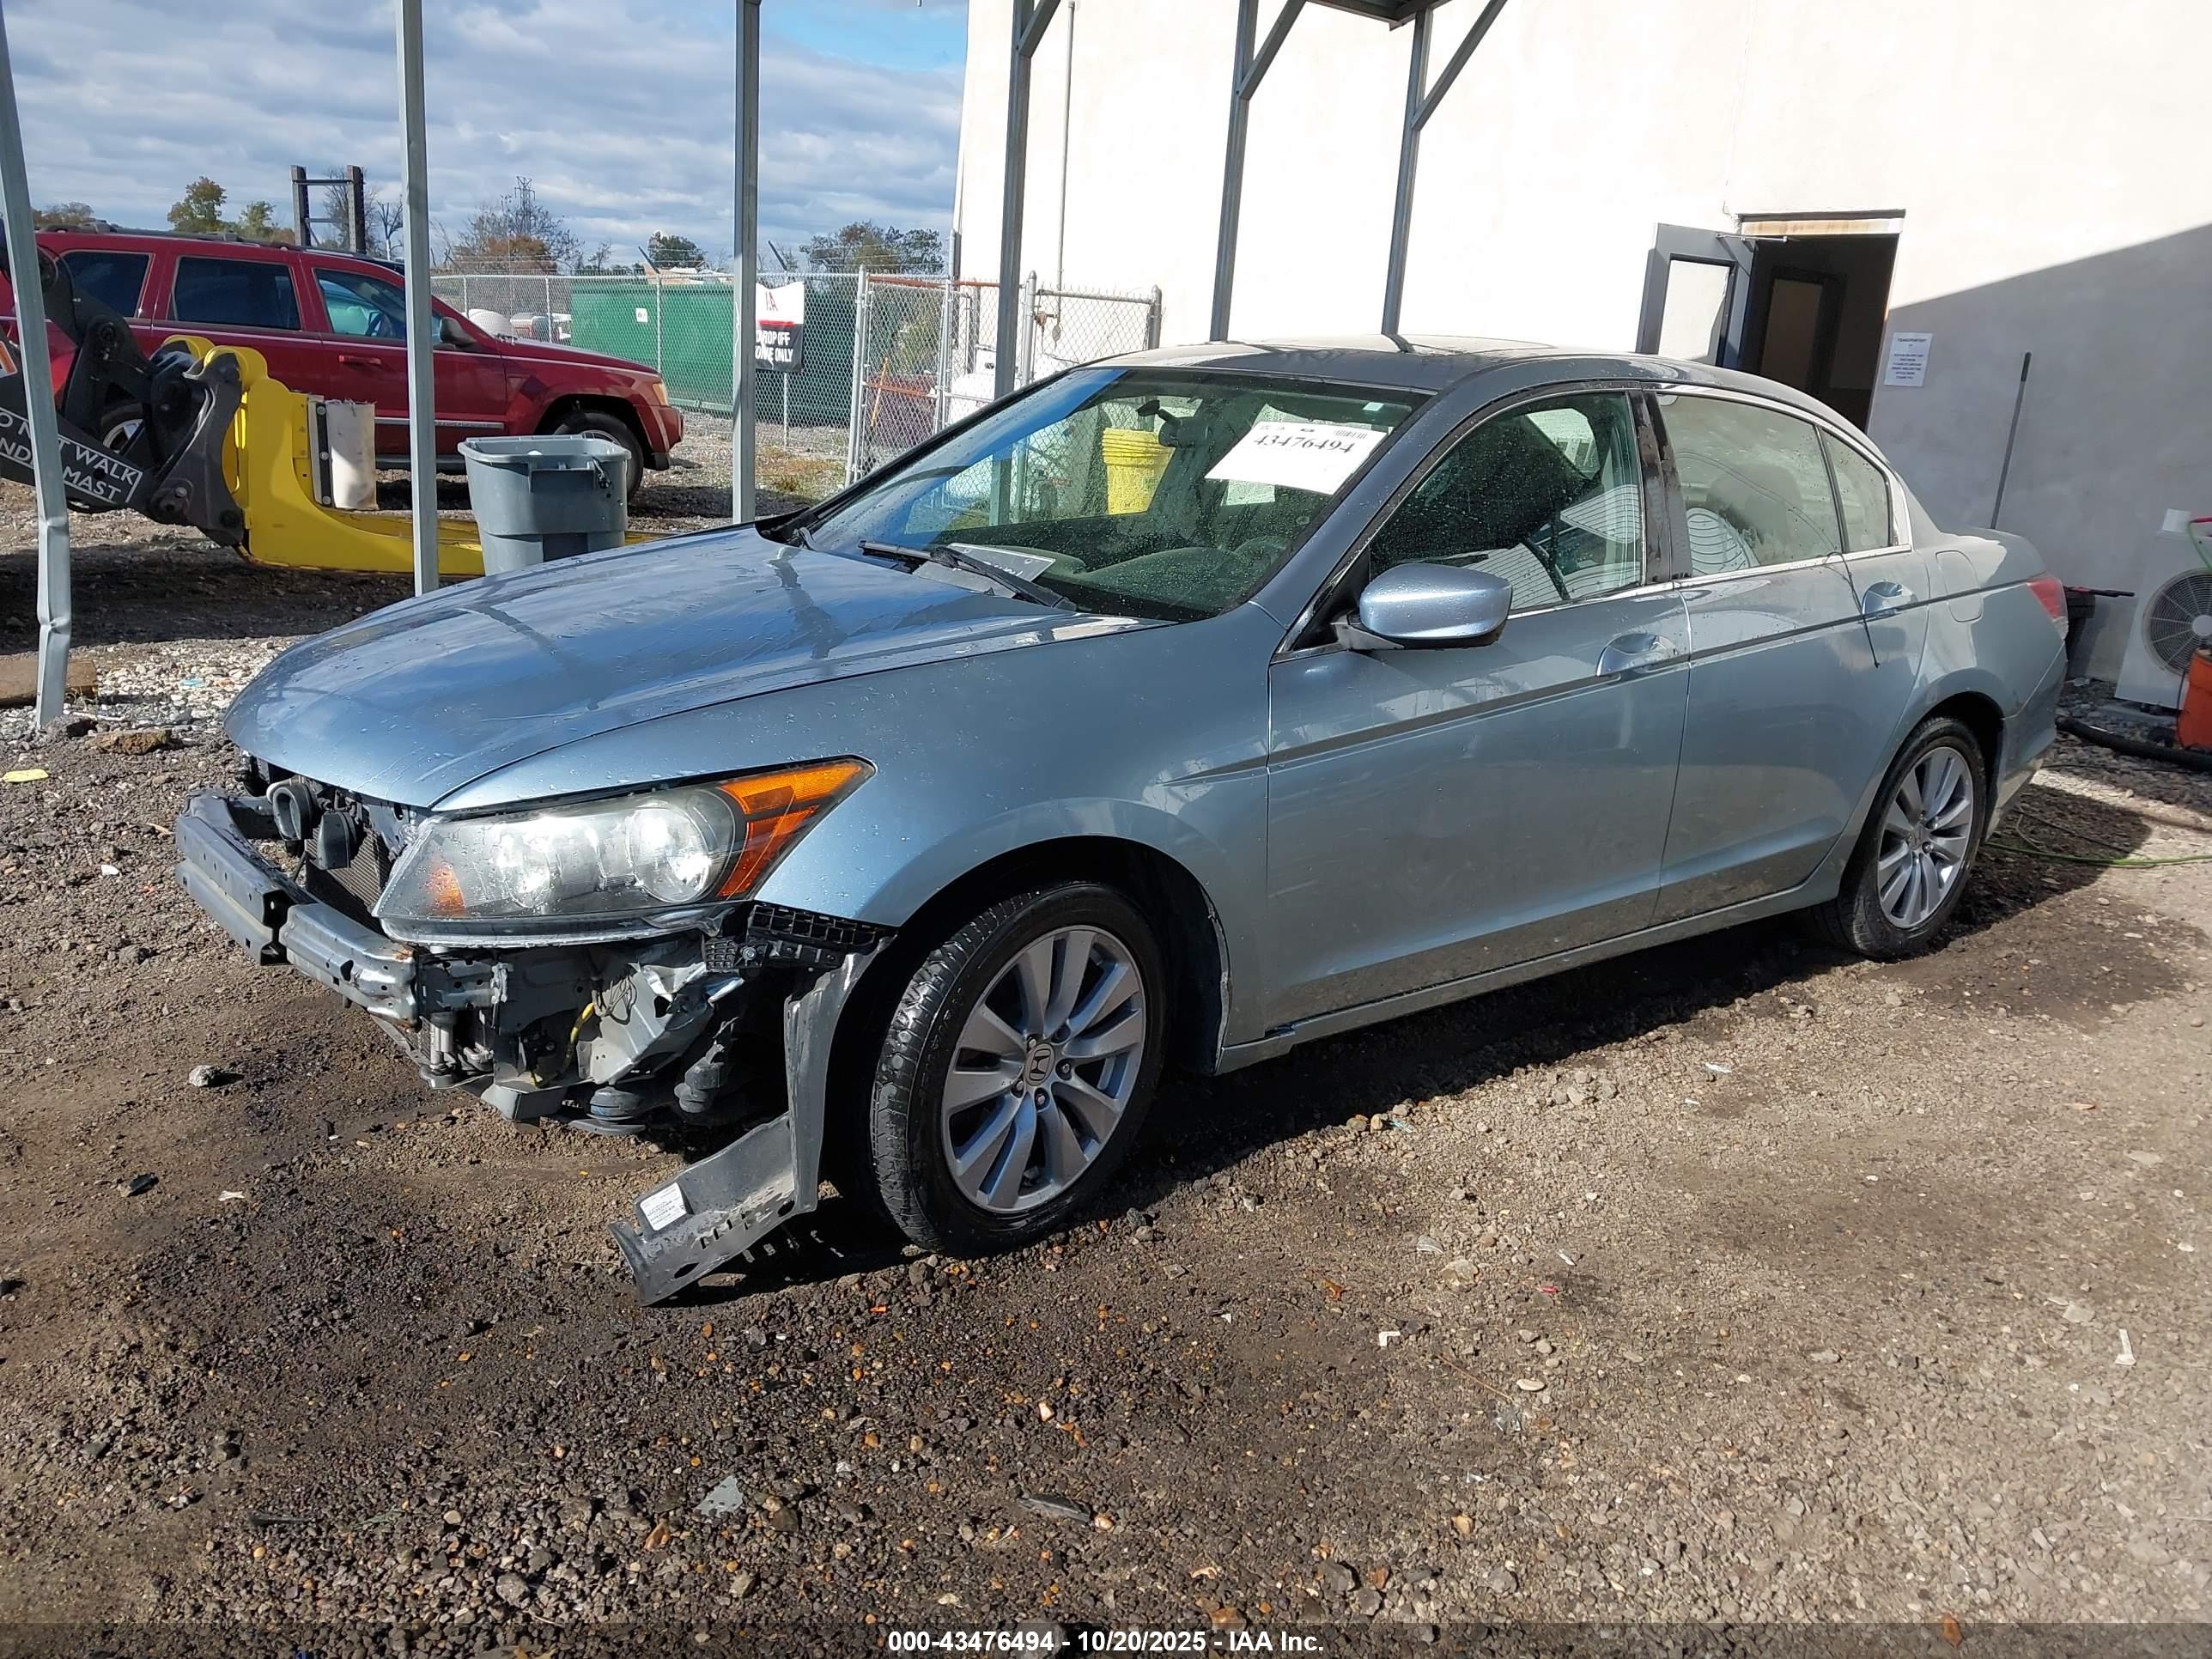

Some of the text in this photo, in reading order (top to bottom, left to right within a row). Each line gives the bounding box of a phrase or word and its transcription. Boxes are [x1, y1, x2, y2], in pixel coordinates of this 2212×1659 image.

[756, 329, 791, 346] DROP OFF
[755, 344, 794, 362] ONE ONLY
[1254, 434, 1355, 453] 43476494
[75, 445, 137, 485] WALK
[63, 465, 122, 501] MAST
